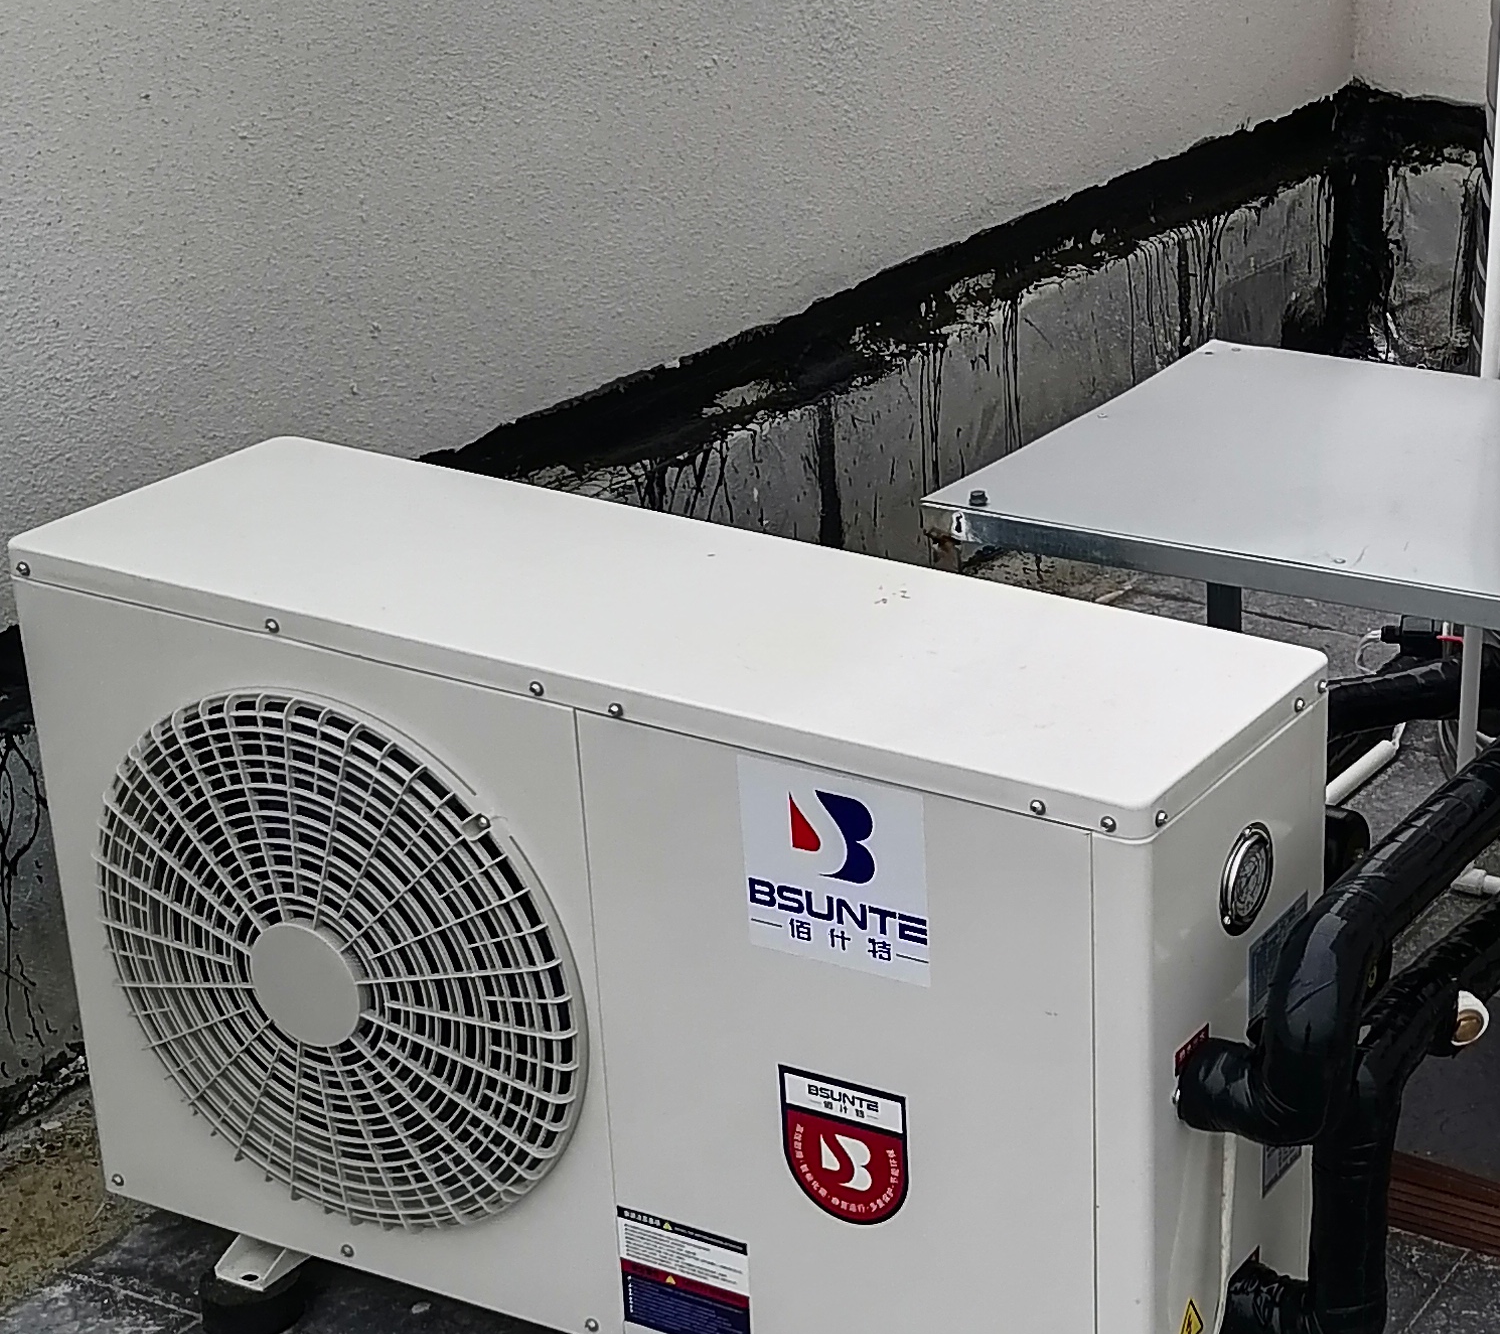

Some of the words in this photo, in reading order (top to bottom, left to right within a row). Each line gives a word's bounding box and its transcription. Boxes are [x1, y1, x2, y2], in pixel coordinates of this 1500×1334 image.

[748, 877, 928, 946] BSUNTE
[789, 918, 892, 962] 佰什特
[807, 1084, 879, 1113] BSUNTE
